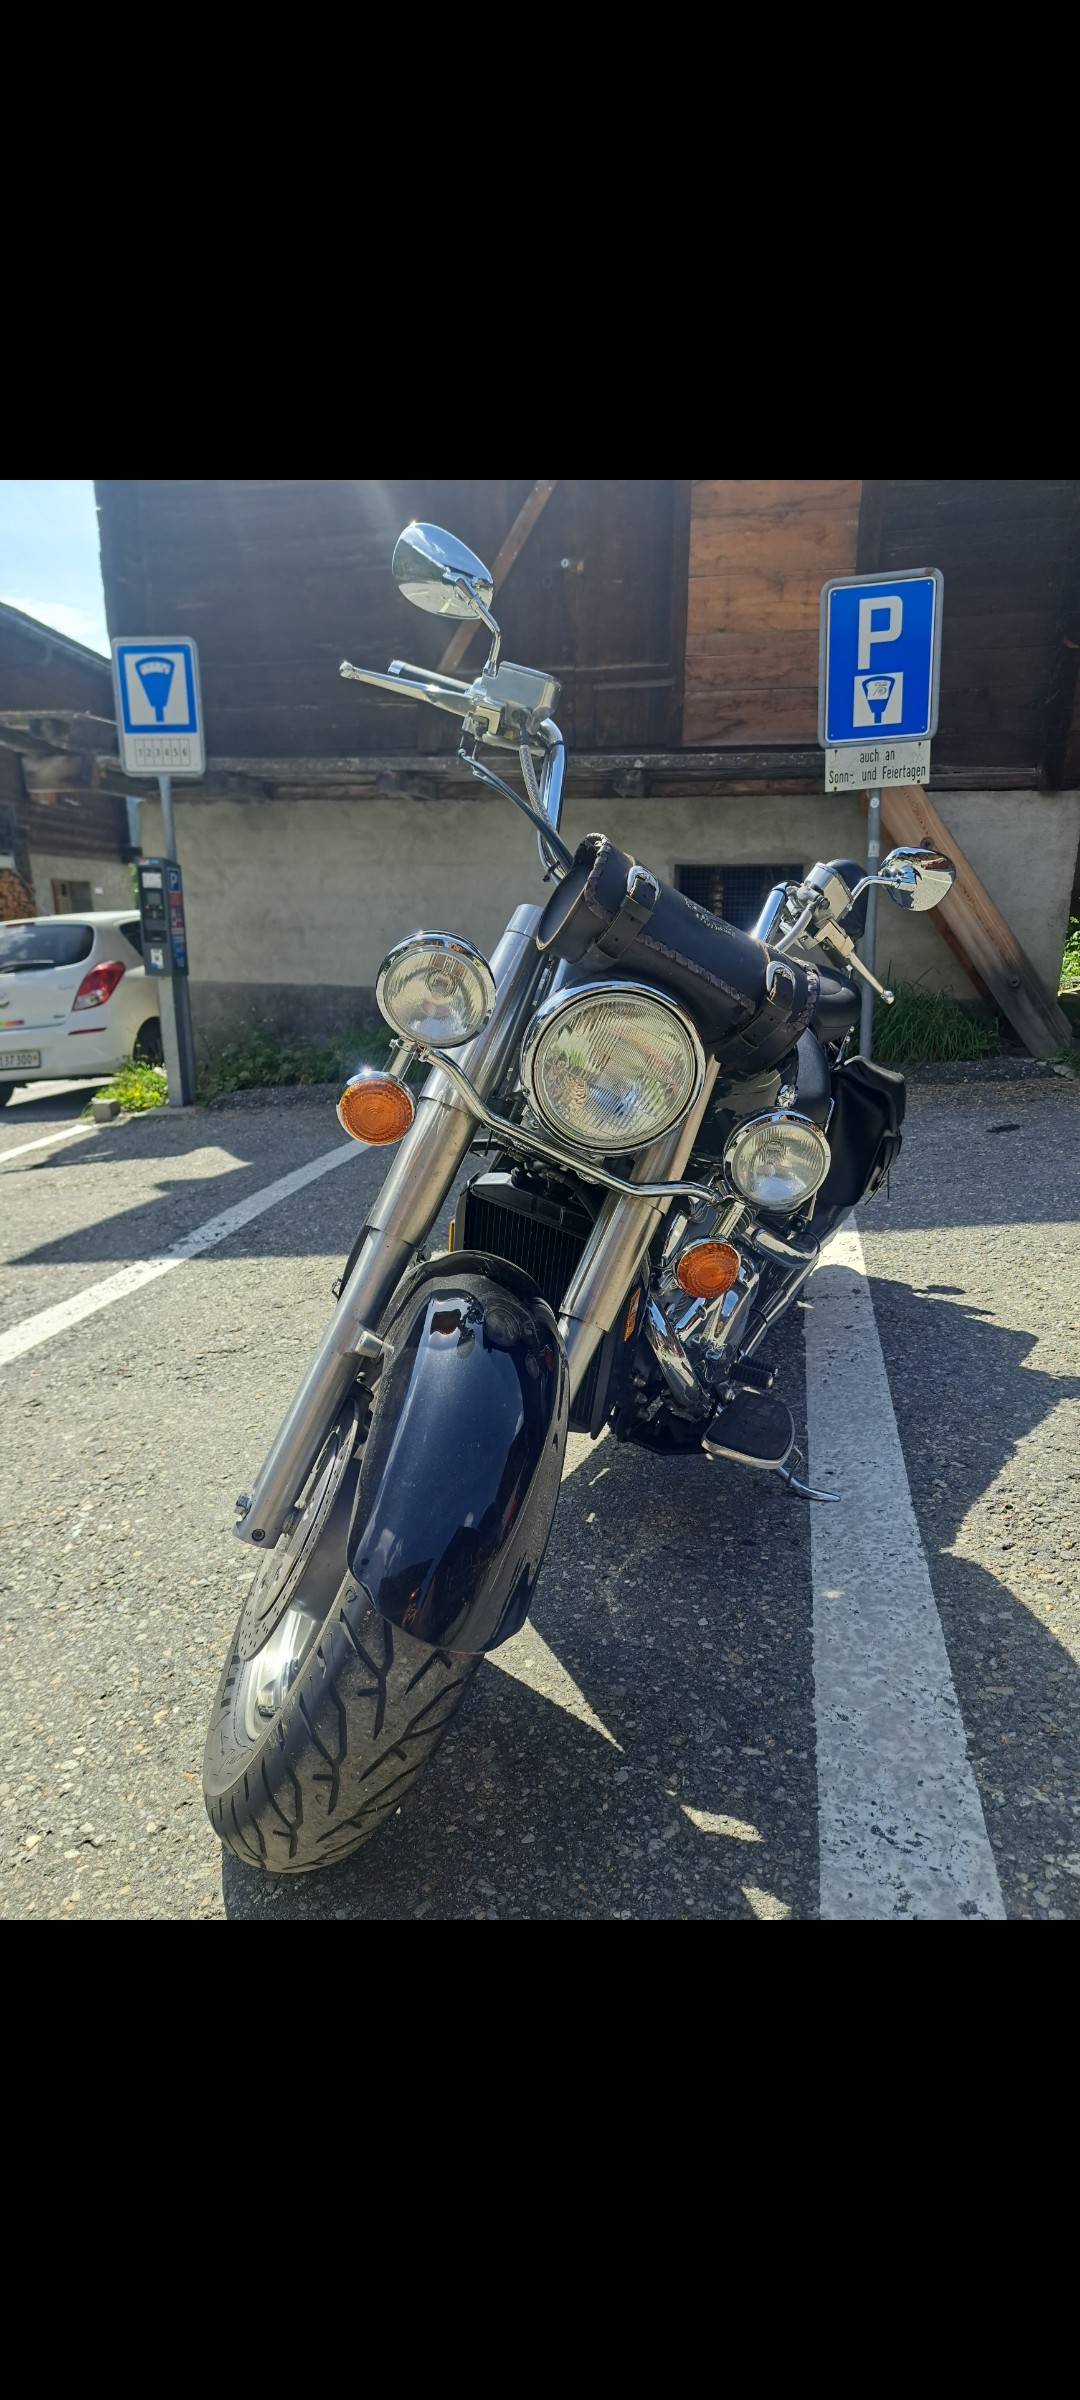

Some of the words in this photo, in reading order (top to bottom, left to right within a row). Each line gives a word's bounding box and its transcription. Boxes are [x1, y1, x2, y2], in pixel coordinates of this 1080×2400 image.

[858, 595, 903, 670] P
[859, 749, 879, 763] auch
[885, 750, 895, 761] an
[862, 767, 877, 781] und
[882, 765, 926, 781] Feiertagen
